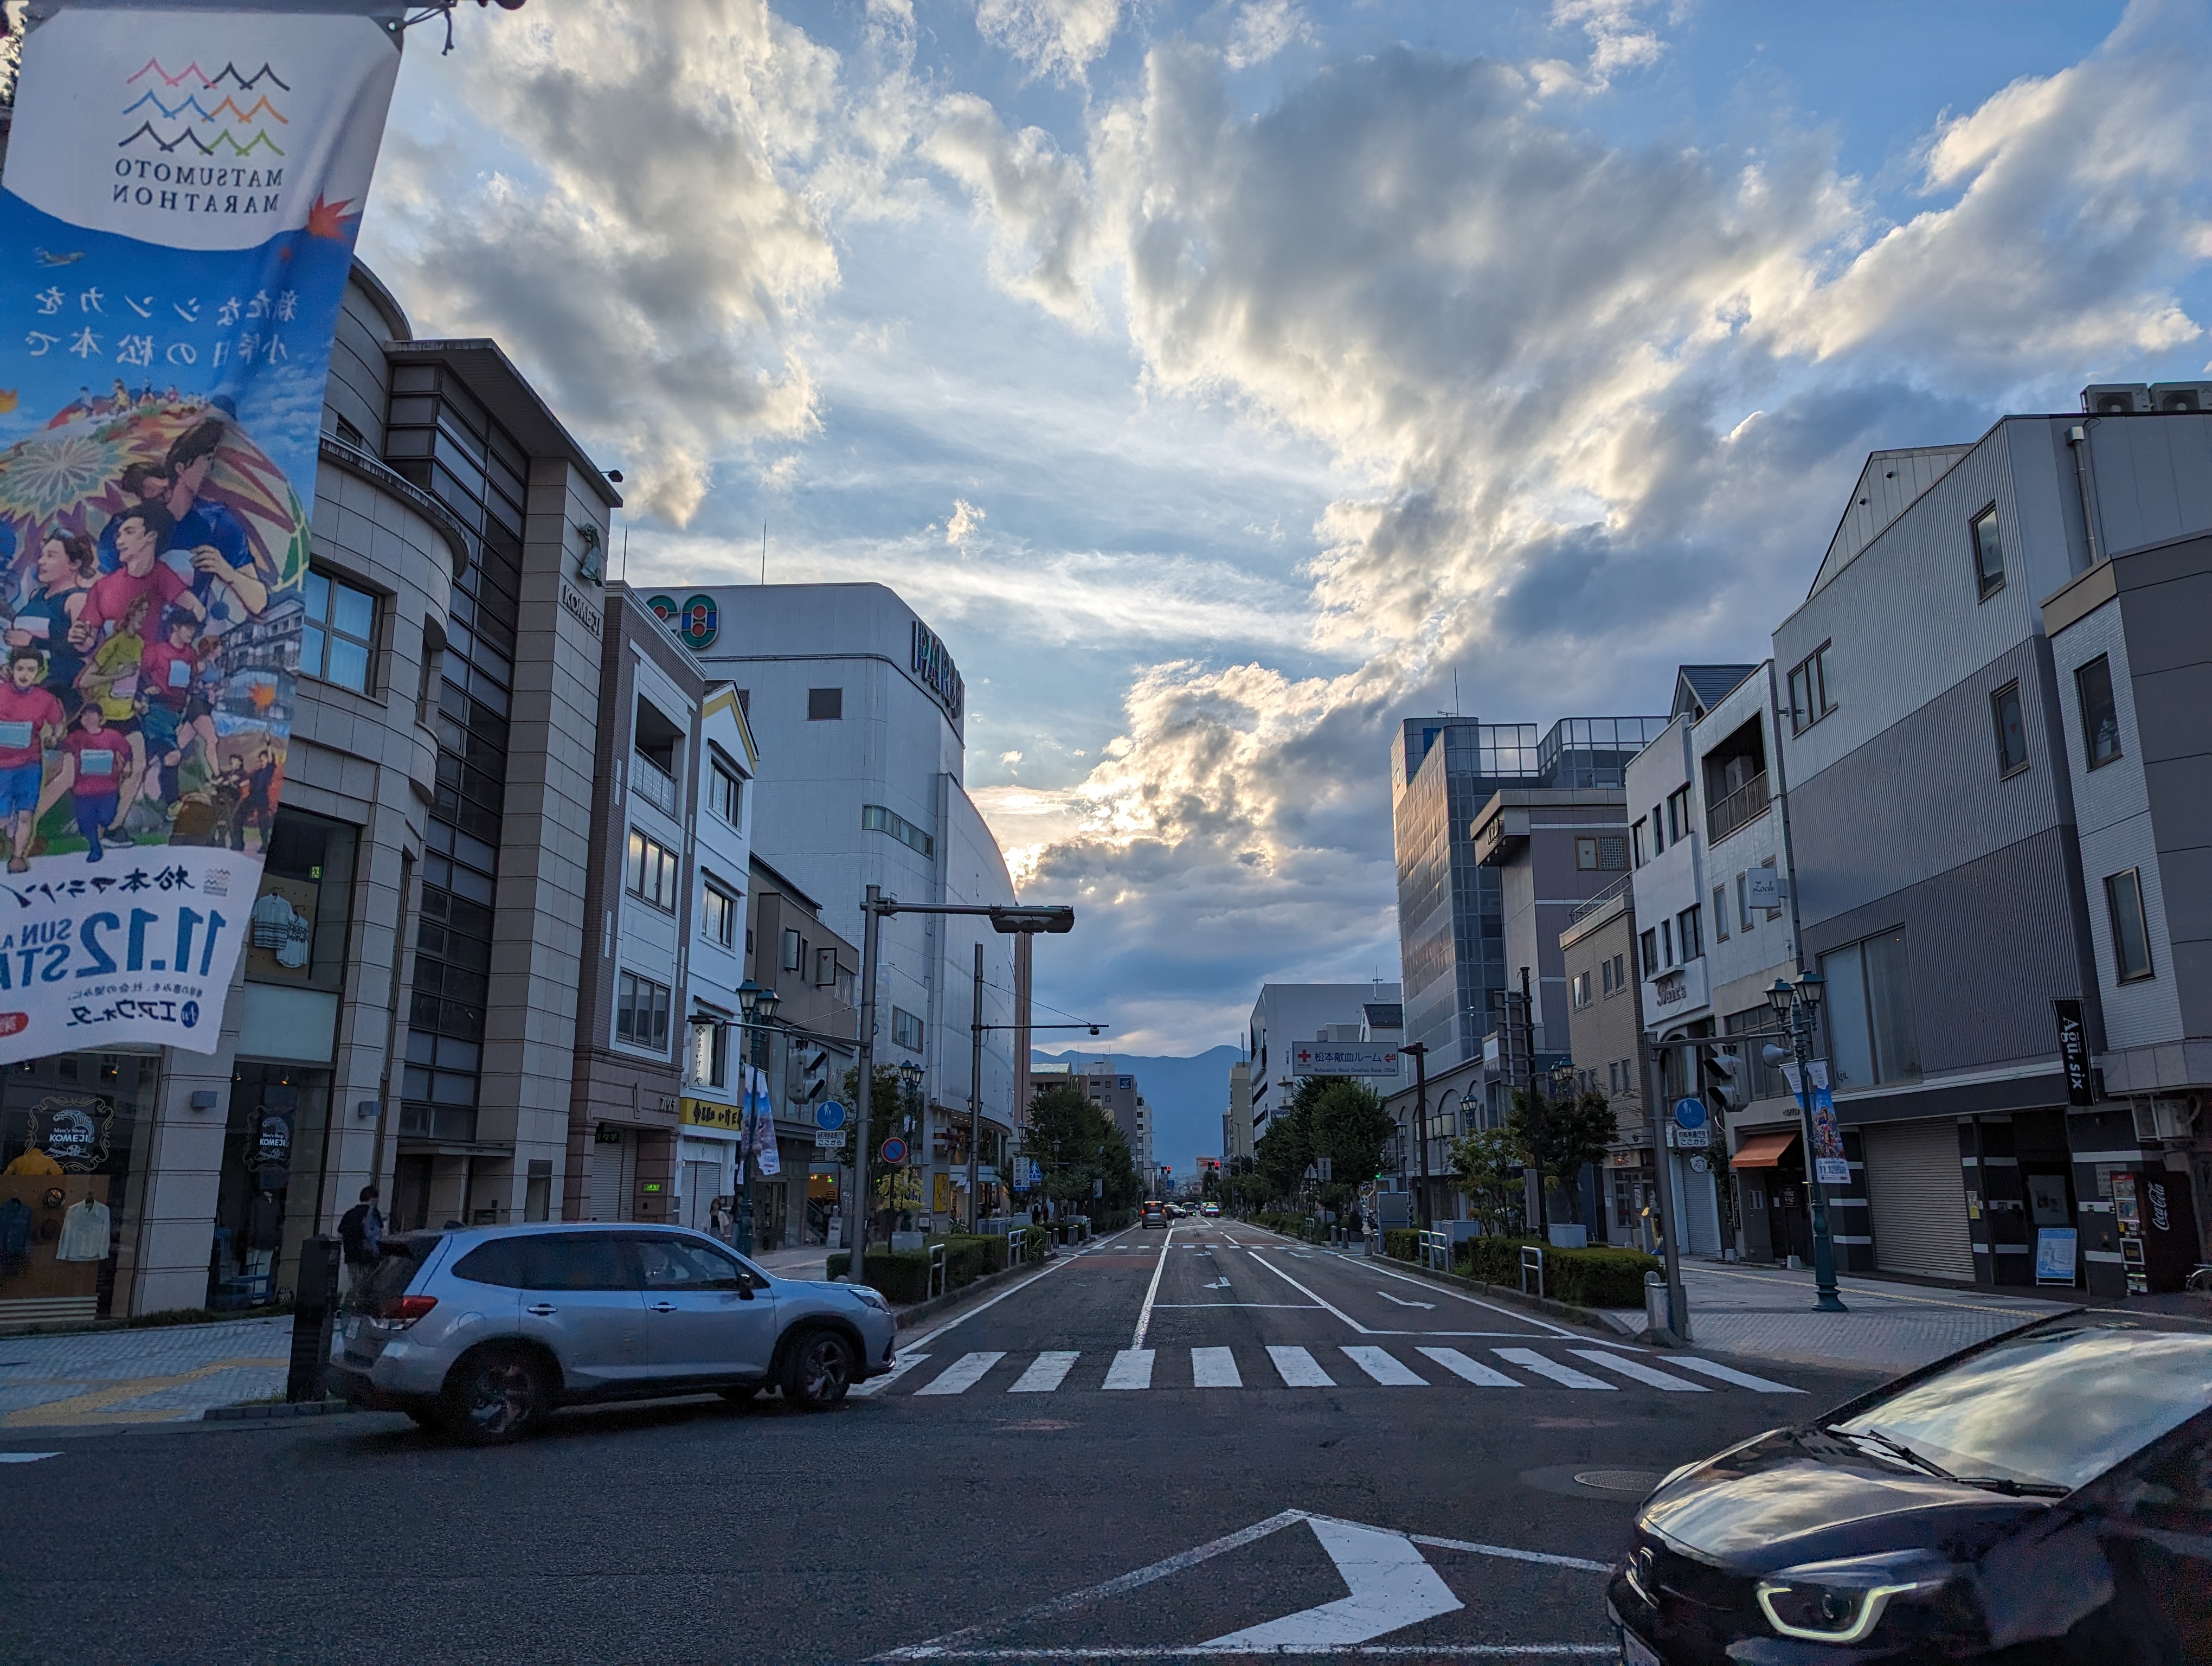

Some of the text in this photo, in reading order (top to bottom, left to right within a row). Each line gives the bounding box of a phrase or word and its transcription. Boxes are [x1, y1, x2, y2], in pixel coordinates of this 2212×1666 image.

[563, 584, 601, 636] KOMEJI
[911, 619, 962, 719] PARCO
[1314, 1052, 1382, 1063] 松本献血ルーム
[49, 1133, 88, 1143] KOMEJI
[260, 1138, 286, 1146] KOMEJI
